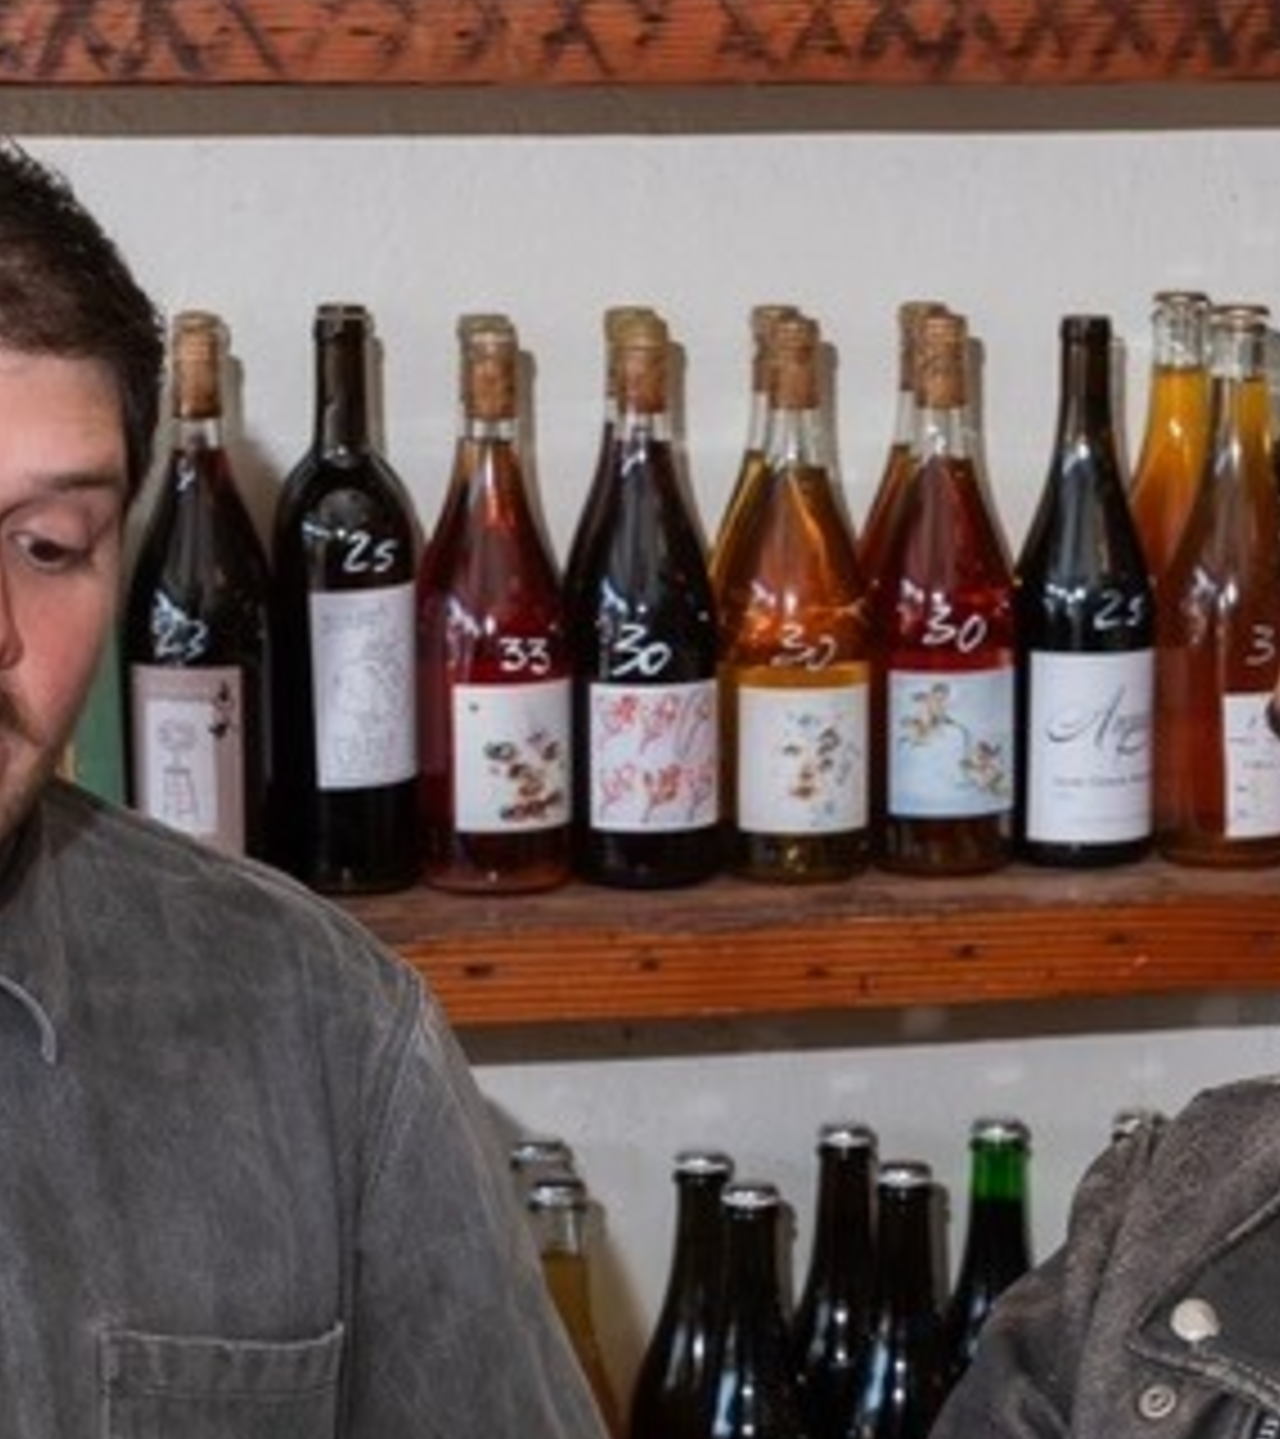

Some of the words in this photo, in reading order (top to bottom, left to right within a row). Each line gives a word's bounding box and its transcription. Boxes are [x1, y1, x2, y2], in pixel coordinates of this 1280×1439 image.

[342, 531, 400, 574] 25
[922, 596, 988, 653] 30
[1246, 624, 1275, 666] 3
[499, 637, 551, 674] 33
[613, 623, 673, 676] 30
